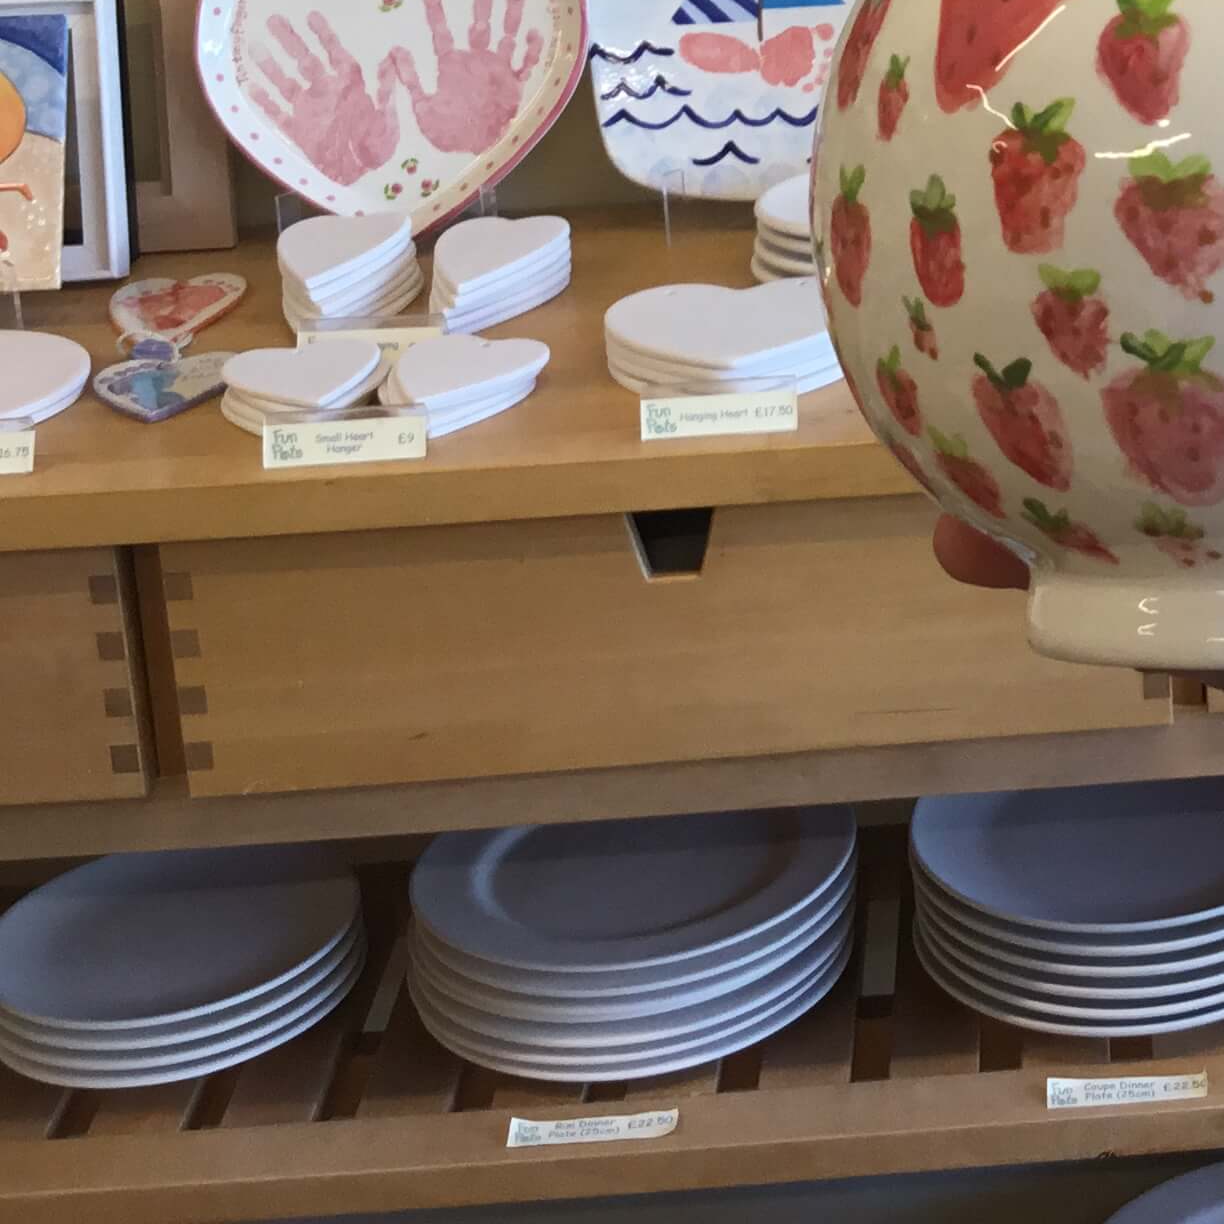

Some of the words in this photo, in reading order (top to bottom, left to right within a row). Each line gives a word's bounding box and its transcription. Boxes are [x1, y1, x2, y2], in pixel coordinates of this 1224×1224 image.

[646, 404, 671, 419] Fun
[680, 412, 717, 423] Hanging
[720, 409, 748, 419] Heart
[755, 405, 793, 417] £17.50
[647, 418, 677, 434] Pots
[272, 429, 297, 444] Fun
[315, 433, 342, 443] Small
[345, 431, 373, 441] Heart
[398, 432, 415, 445] £9
[272, 444, 303, 460] Pots
[326, 444, 362, 455] Hanger
[1050, 1082, 1073, 1094] Fun
[1084, 1082, 1116, 1092] Coupe
[1119, 1080, 1153, 1089] Dinner
[1085, 1091, 1113, 1102] Plate
[1116, 1089, 1155, 1100] (25cm)
[627, 1115, 673, 1129] £22.50
